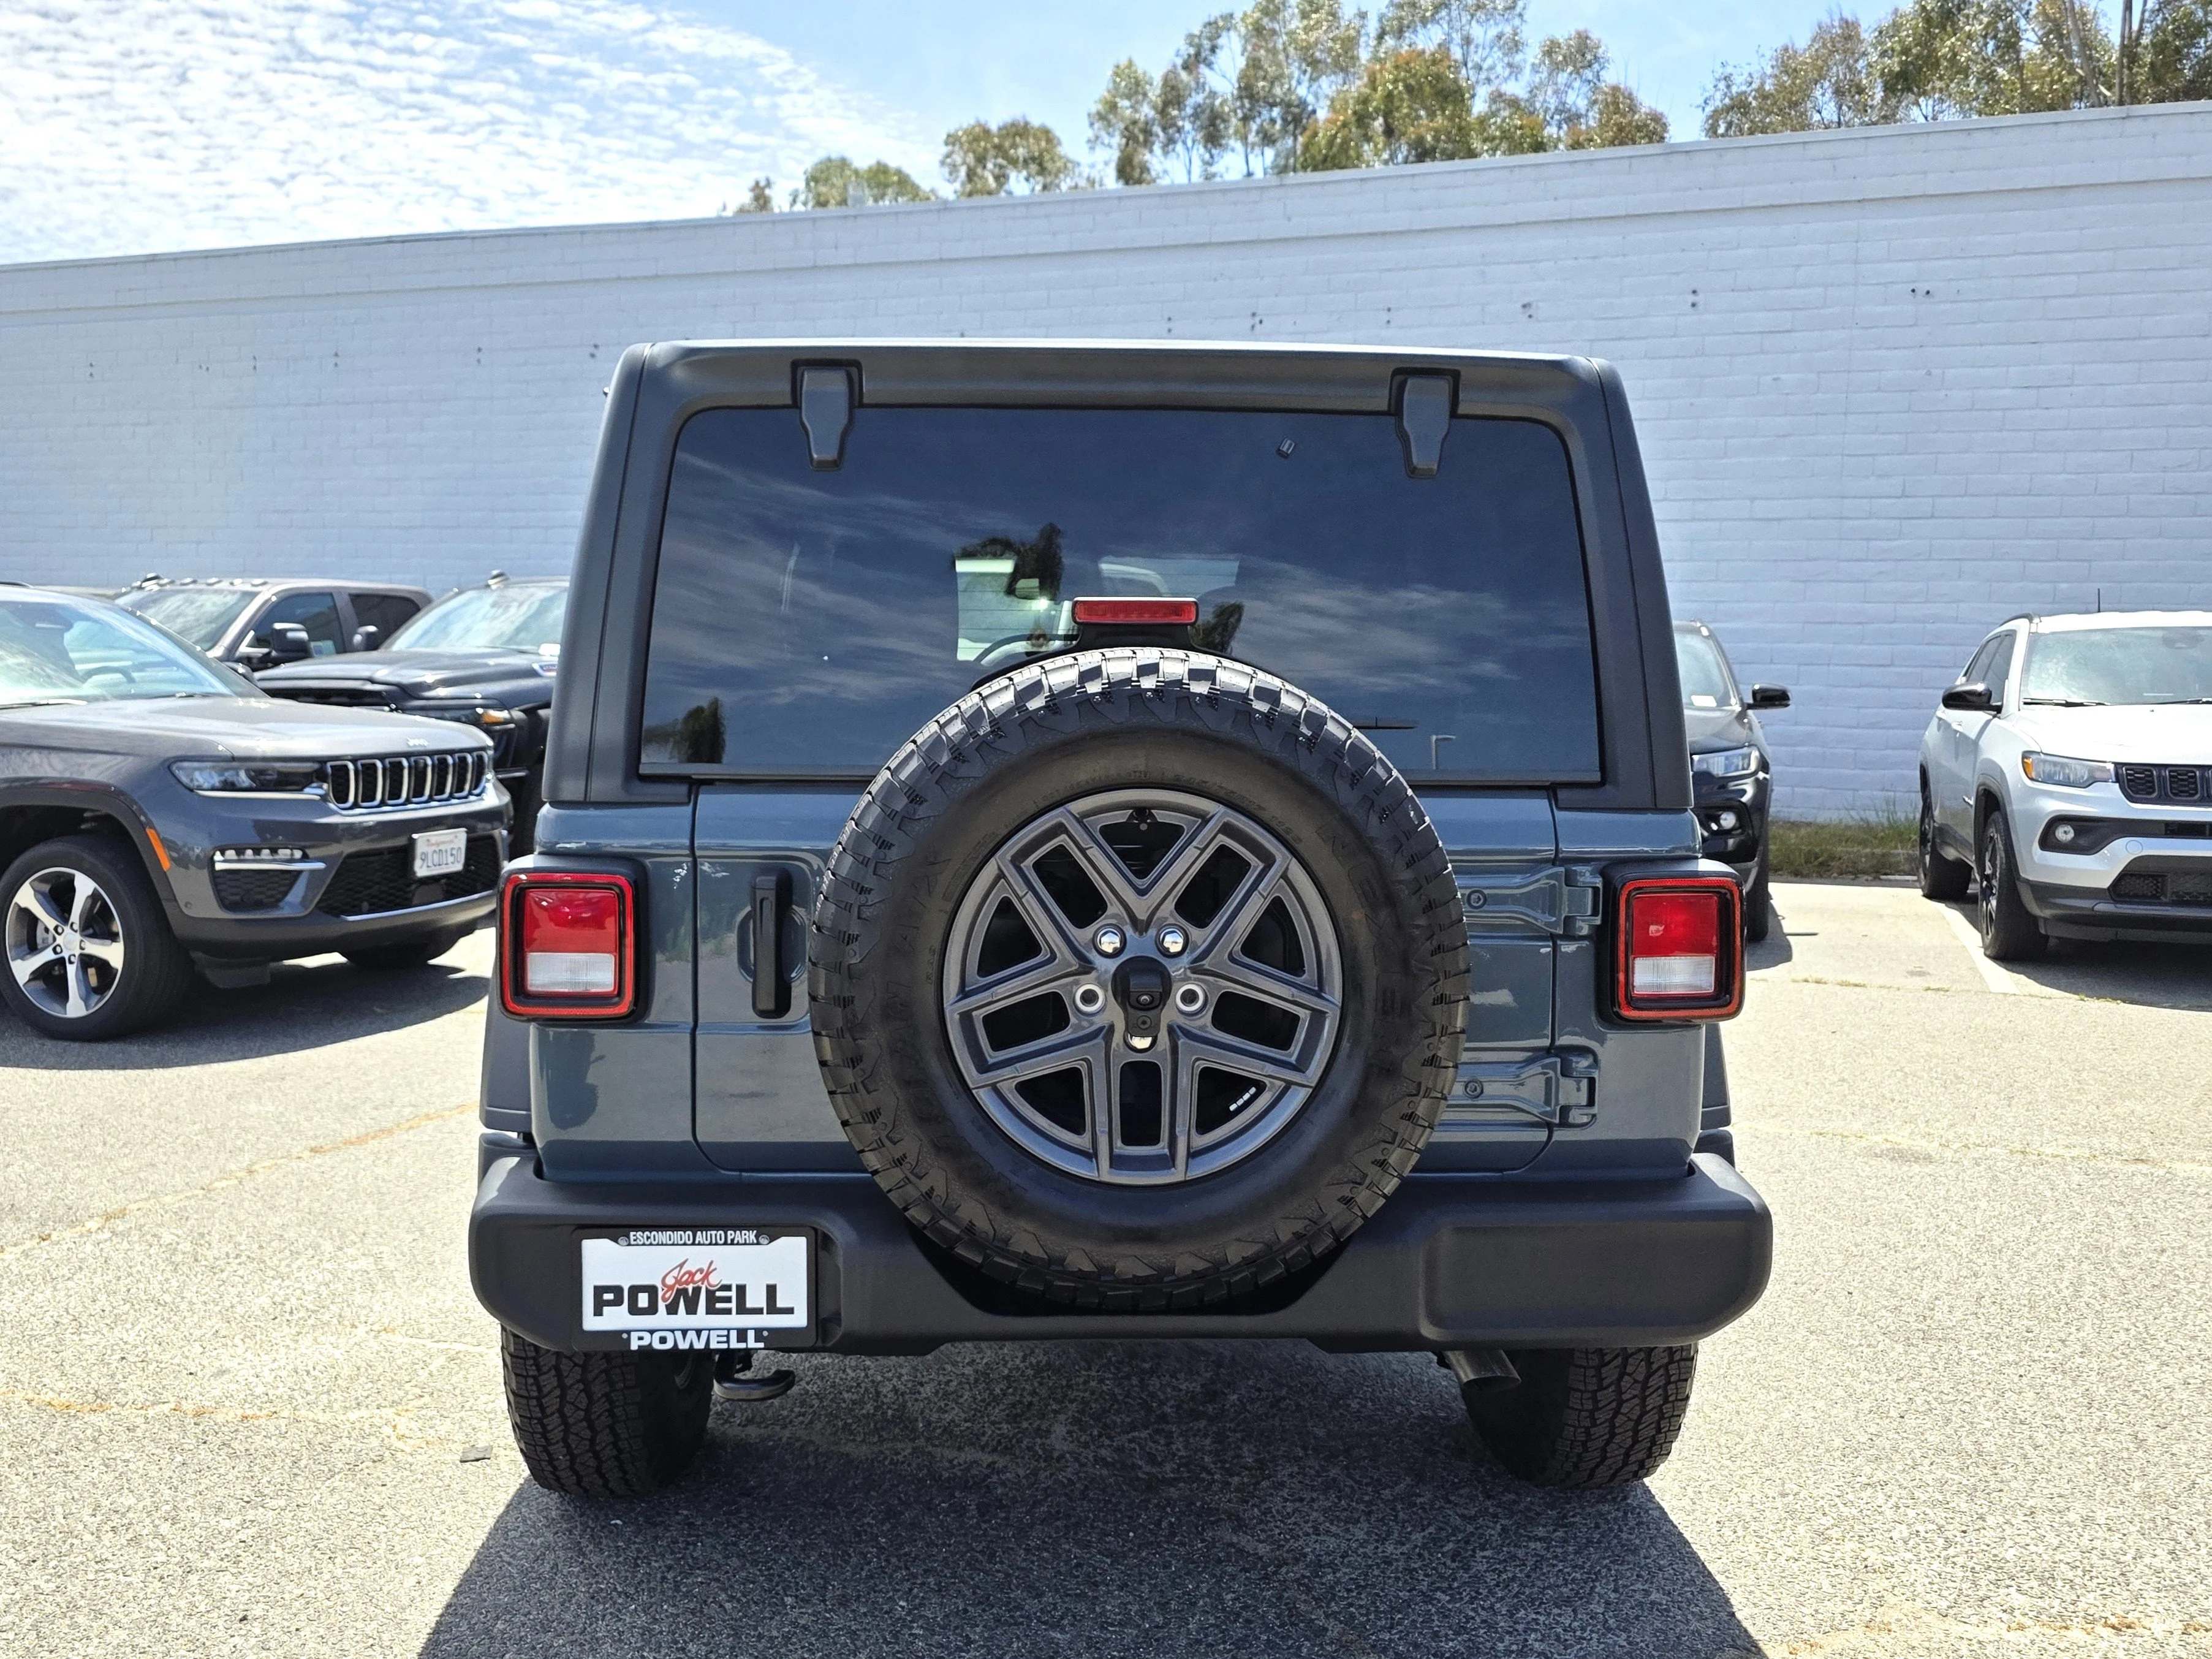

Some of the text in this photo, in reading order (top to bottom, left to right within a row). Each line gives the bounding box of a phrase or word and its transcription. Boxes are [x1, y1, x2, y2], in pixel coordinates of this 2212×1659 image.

[420, 847, 462, 869] 9LCD150
[629, 1230, 757, 1245] ESCONDIDO AUTO PARK
[661, 1258, 722, 1304] Jack
[593, 1283, 795, 1317] POWELL
[630, 1329, 764, 1350] POWELL
